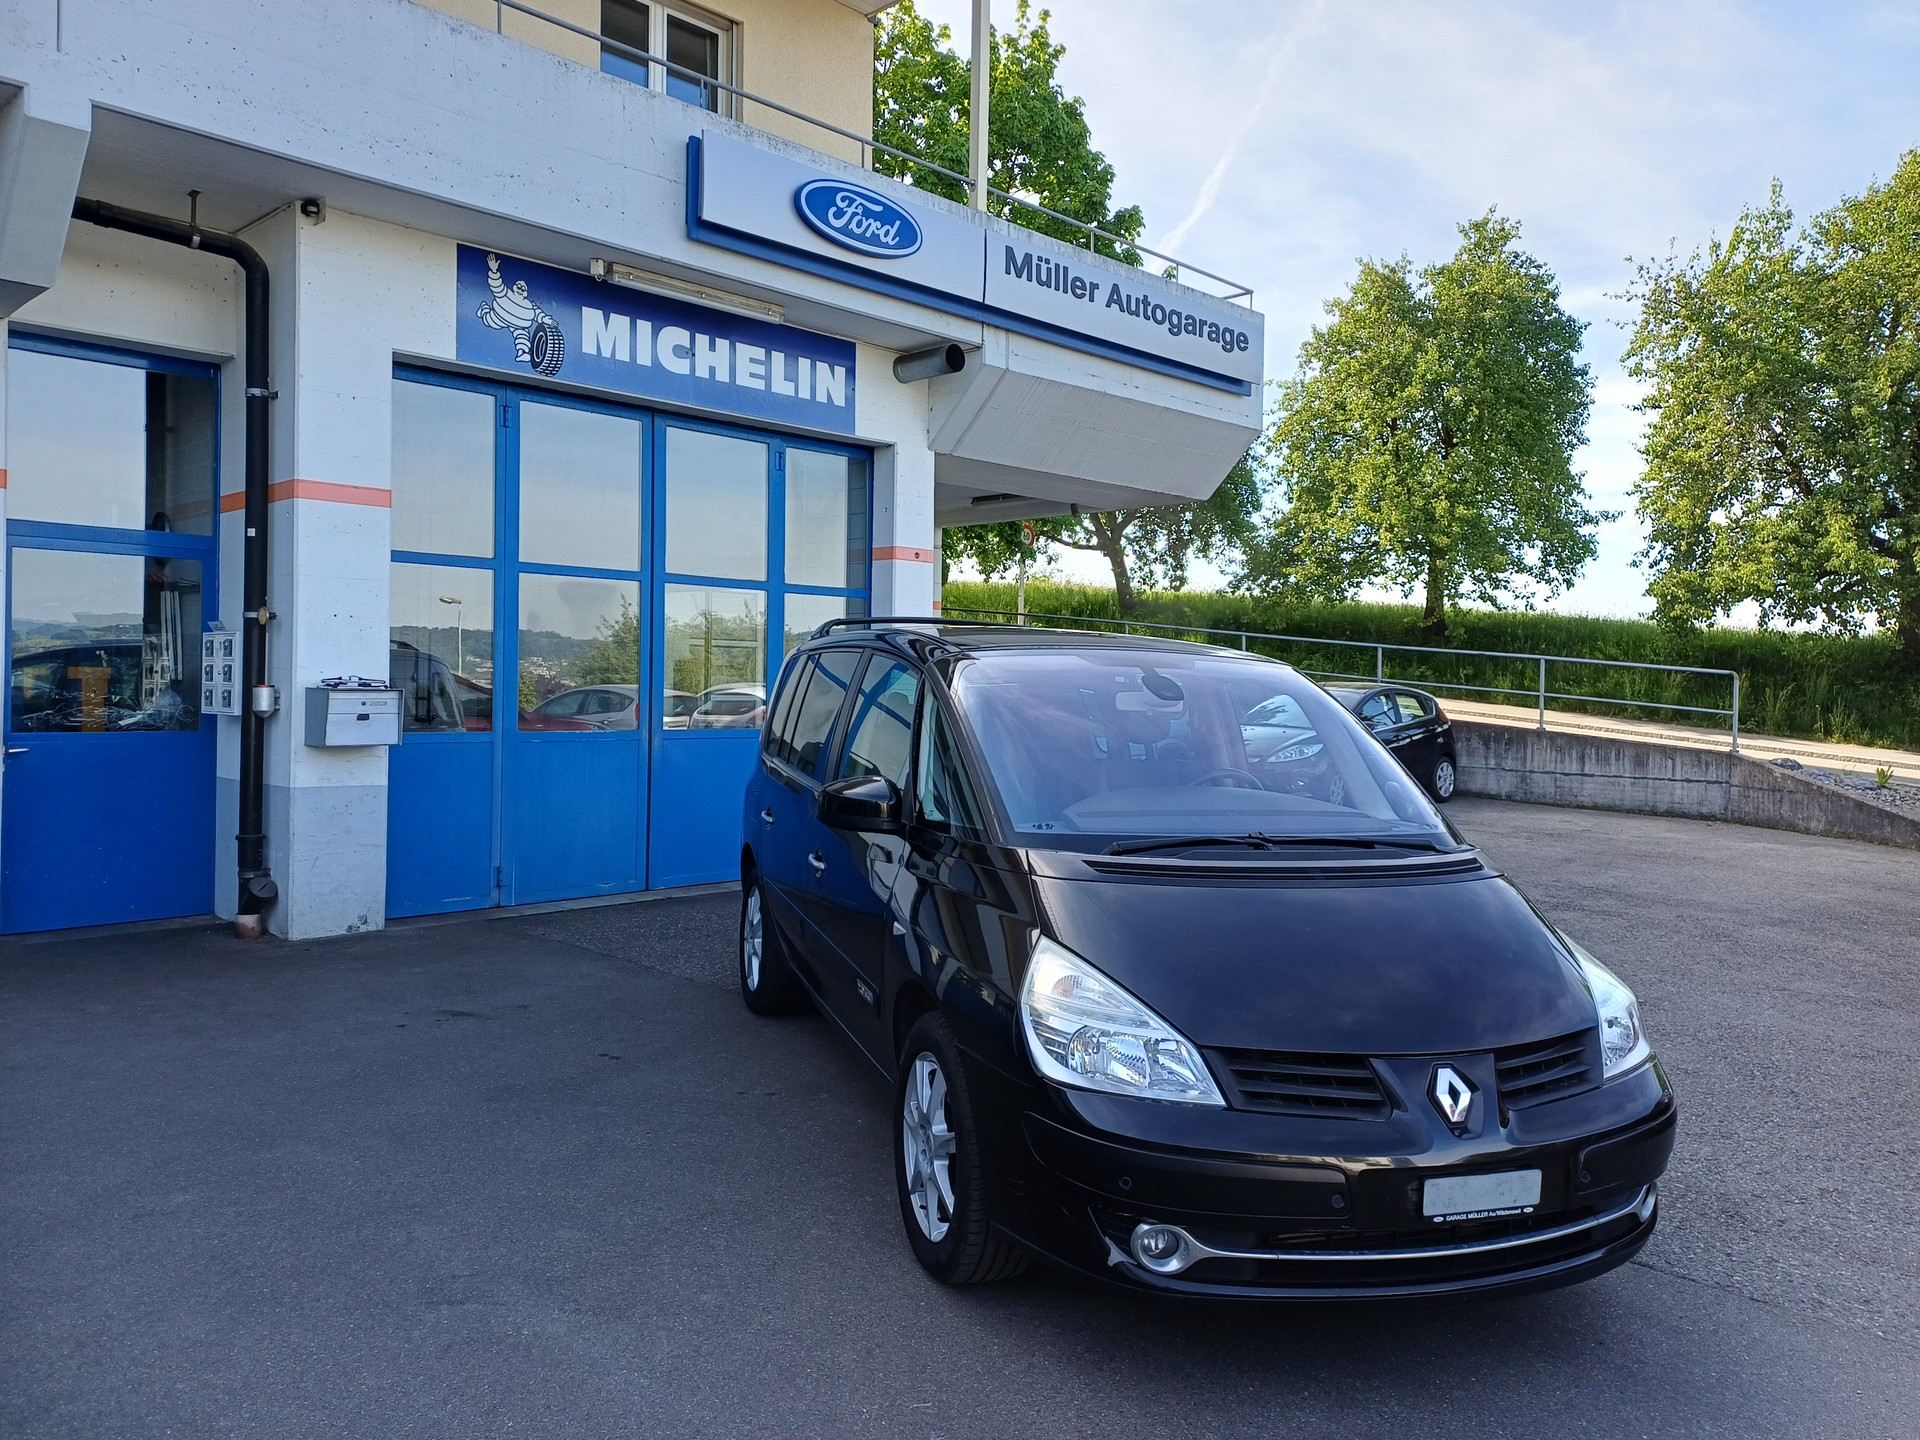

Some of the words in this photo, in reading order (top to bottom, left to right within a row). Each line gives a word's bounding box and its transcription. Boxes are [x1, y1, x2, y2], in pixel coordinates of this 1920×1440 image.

[827, 191, 901, 246] Ford
[1004, 245, 1100, 303] Müller
[1105, 283, 1250, 354] Autogarage
[582, 306, 846, 407] MICHELIN
[1446, 1212, 1467, 1221] GARAGE
[1467, 1211, 1488, 1219] MÜLLER
